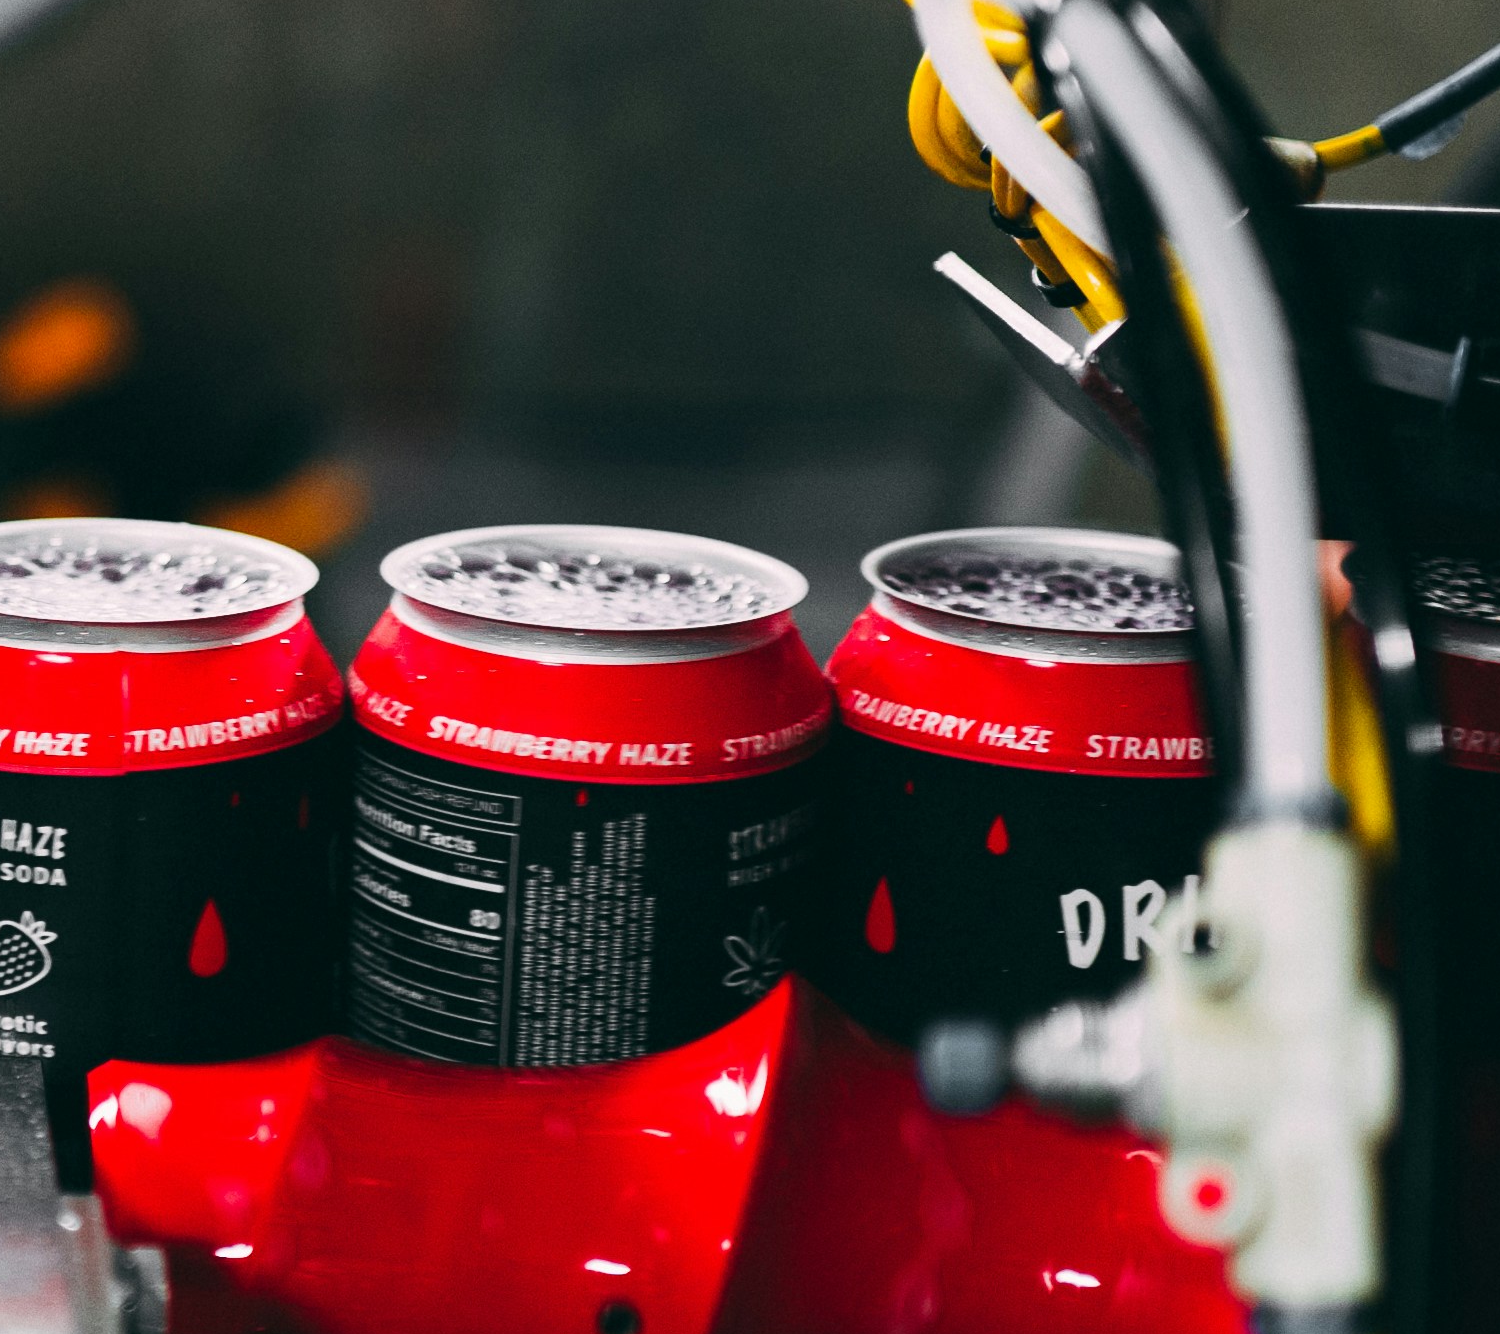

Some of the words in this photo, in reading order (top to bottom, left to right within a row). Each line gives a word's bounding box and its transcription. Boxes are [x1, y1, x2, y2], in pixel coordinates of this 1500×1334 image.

[13, 730, 91, 757] HAZE
[123, 707, 282, 754] TRAWBERRY
[426, 715, 613, 764] STRAWBERRY
[619, 742, 695, 766] HAZE
[978, 721, 1054, 753] HAZE
[0, 819, 68, 860] HAZE
[0, 862, 67, 887] SODA
